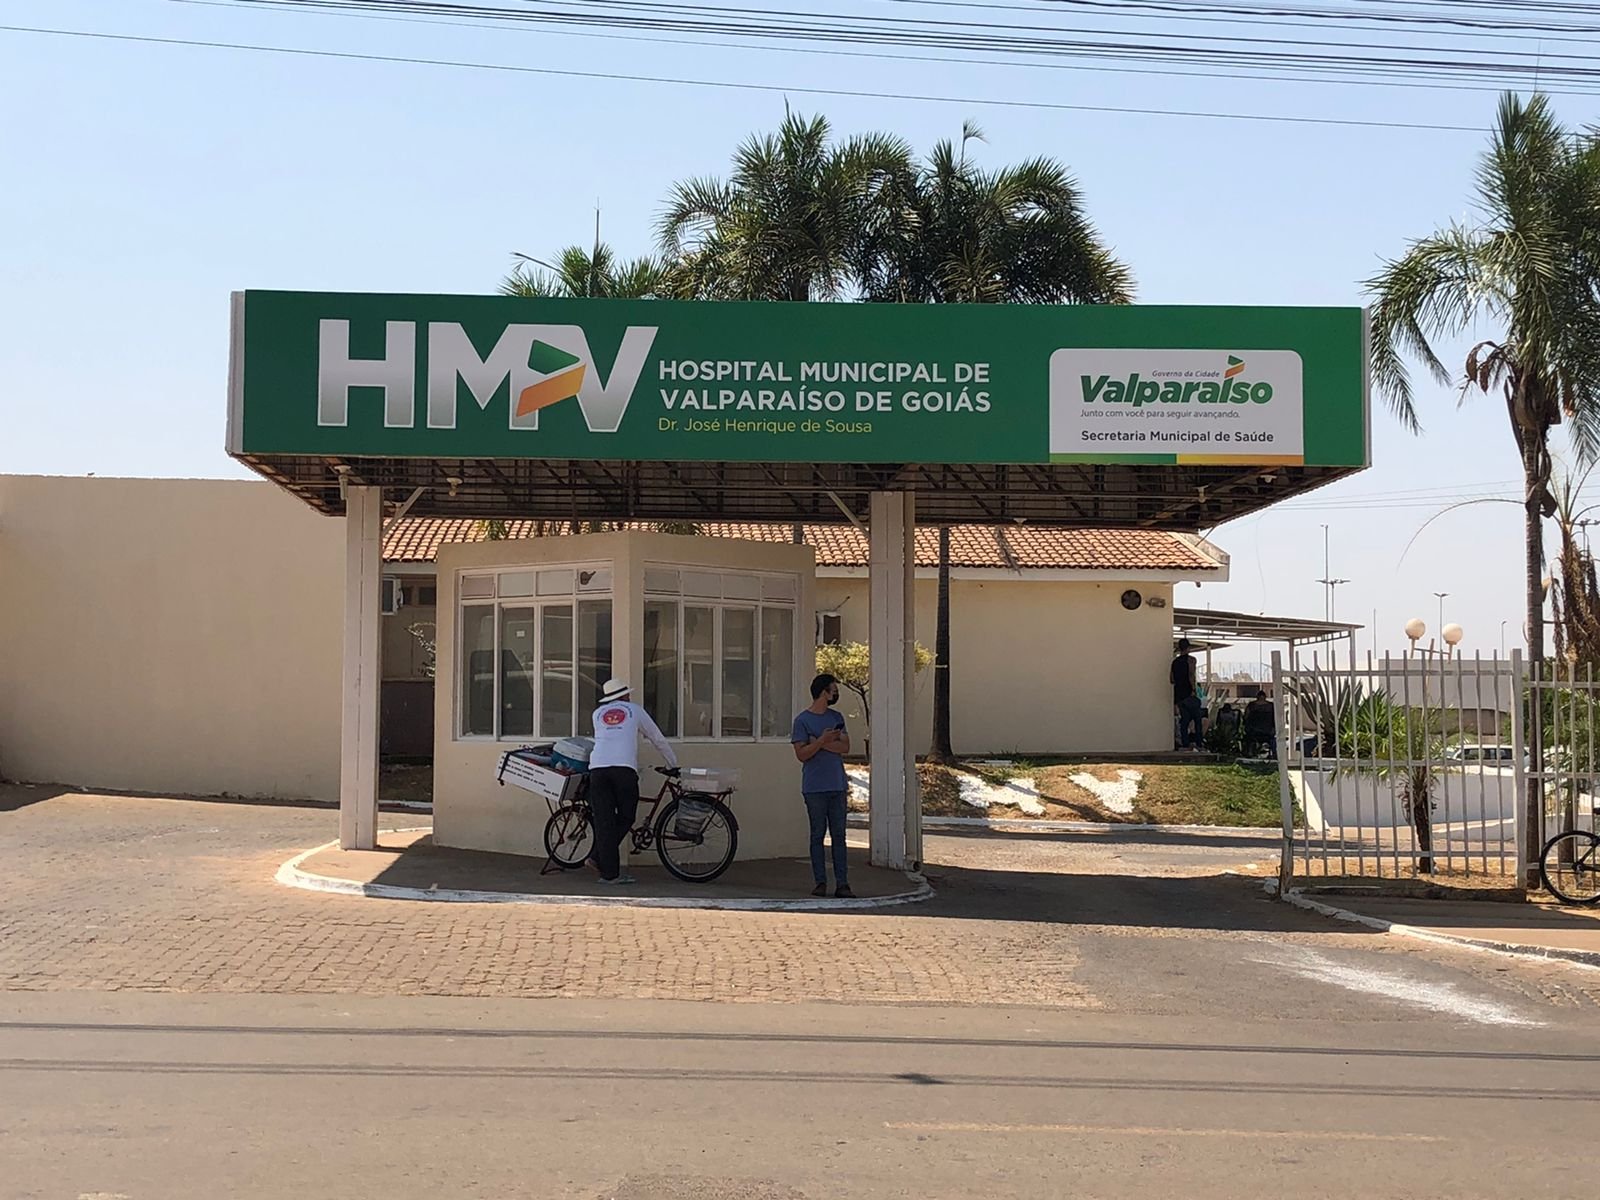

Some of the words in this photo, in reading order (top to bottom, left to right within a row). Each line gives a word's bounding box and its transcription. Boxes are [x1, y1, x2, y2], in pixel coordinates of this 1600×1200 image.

[658, 360, 793, 382] HOSPITAL
[800, 362, 947, 383] MUNICIPAL
[954, 363, 990, 383] DE
[1151, 370, 1183, 378] Governo
[1184, 370, 1194, 378] da
[1195, 370, 1220, 378] Cidade
[659, 385, 846, 412] VALPARAÍSO
[855, 391, 892, 412] DE
[901, 386, 991, 412] GOIÁS
[1080, 409, 1104, 418] Junto
[1105, 410, 1124, 418] com
[1125, 409, 1145, 418] você
[1146, 410, 1165, 419] para
[1166, 409, 1192, 420] seguir
[1193, 409, 1240, 420] avançando.
[658, 417, 679, 431] Dr.
[683, 417, 721, 432] José
[725, 418, 797, 434] Henrique
[800, 419, 821, 432] de
[825, 419, 873, 433] Sousa
[1081, 430, 1146, 441] Secretaria
[1150, 430, 1211, 443] Municipal
[1214, 431, 1231, 442] de
[1234, 430, 1274, 442] Saúde
